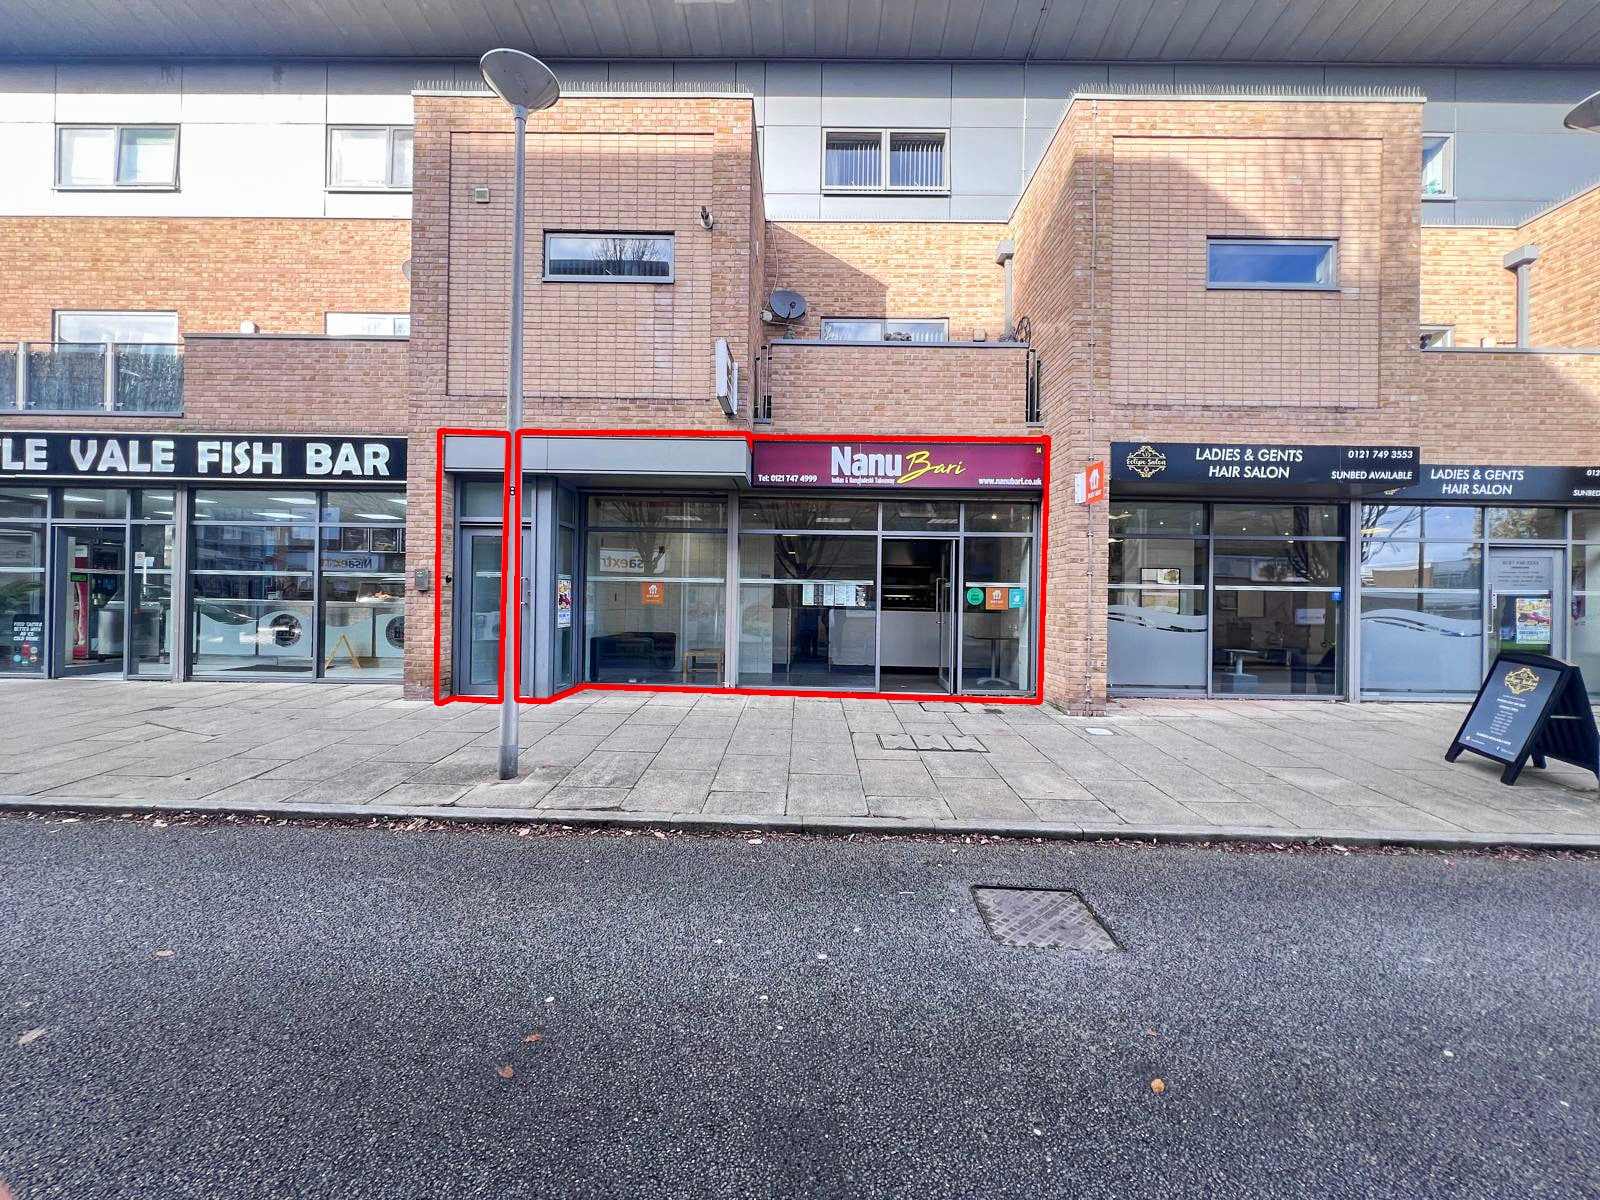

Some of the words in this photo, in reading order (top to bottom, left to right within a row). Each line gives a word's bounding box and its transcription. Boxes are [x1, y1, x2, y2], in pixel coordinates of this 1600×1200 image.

[0, 438, 48, 470] LE
[70, 439, 175, 473] VALE
[197, 440, 282, 475] FISH
[306, 442, 390, 476] BAR
[1195, 448, 1241, 461] LADIES
[1244, 448, 1254, 462] &
[1257, 449, 1304, 462] GENTS
[1348, 450, 1369, 459] 0121
[1372, 450, 1390, 459] 749
[1391, 450, 1413, 459] 3553
[831, 446, 902, 477] Nanu
[896, 450, 967, 484] Bari
[757, 474, 770, 482] Tel:
[770, 474, 785, 482] 0121
[785, 474, 799, 482] 747
[799, 474, 818, 483] 4999
[1208, 465, 1241, 478] HAIR
[1243, 466, 1290, 479] SALON
[1331, 470, 1368, 480] SUNBED
[1368, 471, 1413, 480] AVAILABLE
[1430, 468, 1470, 480] LADIES
[1473, 469, 1482, 481] &
[1486, 469, 1525, 481] GENTS
[1441, 484, 1470, 495] HAIR
[1472, 484, 1513, 496] SALON
